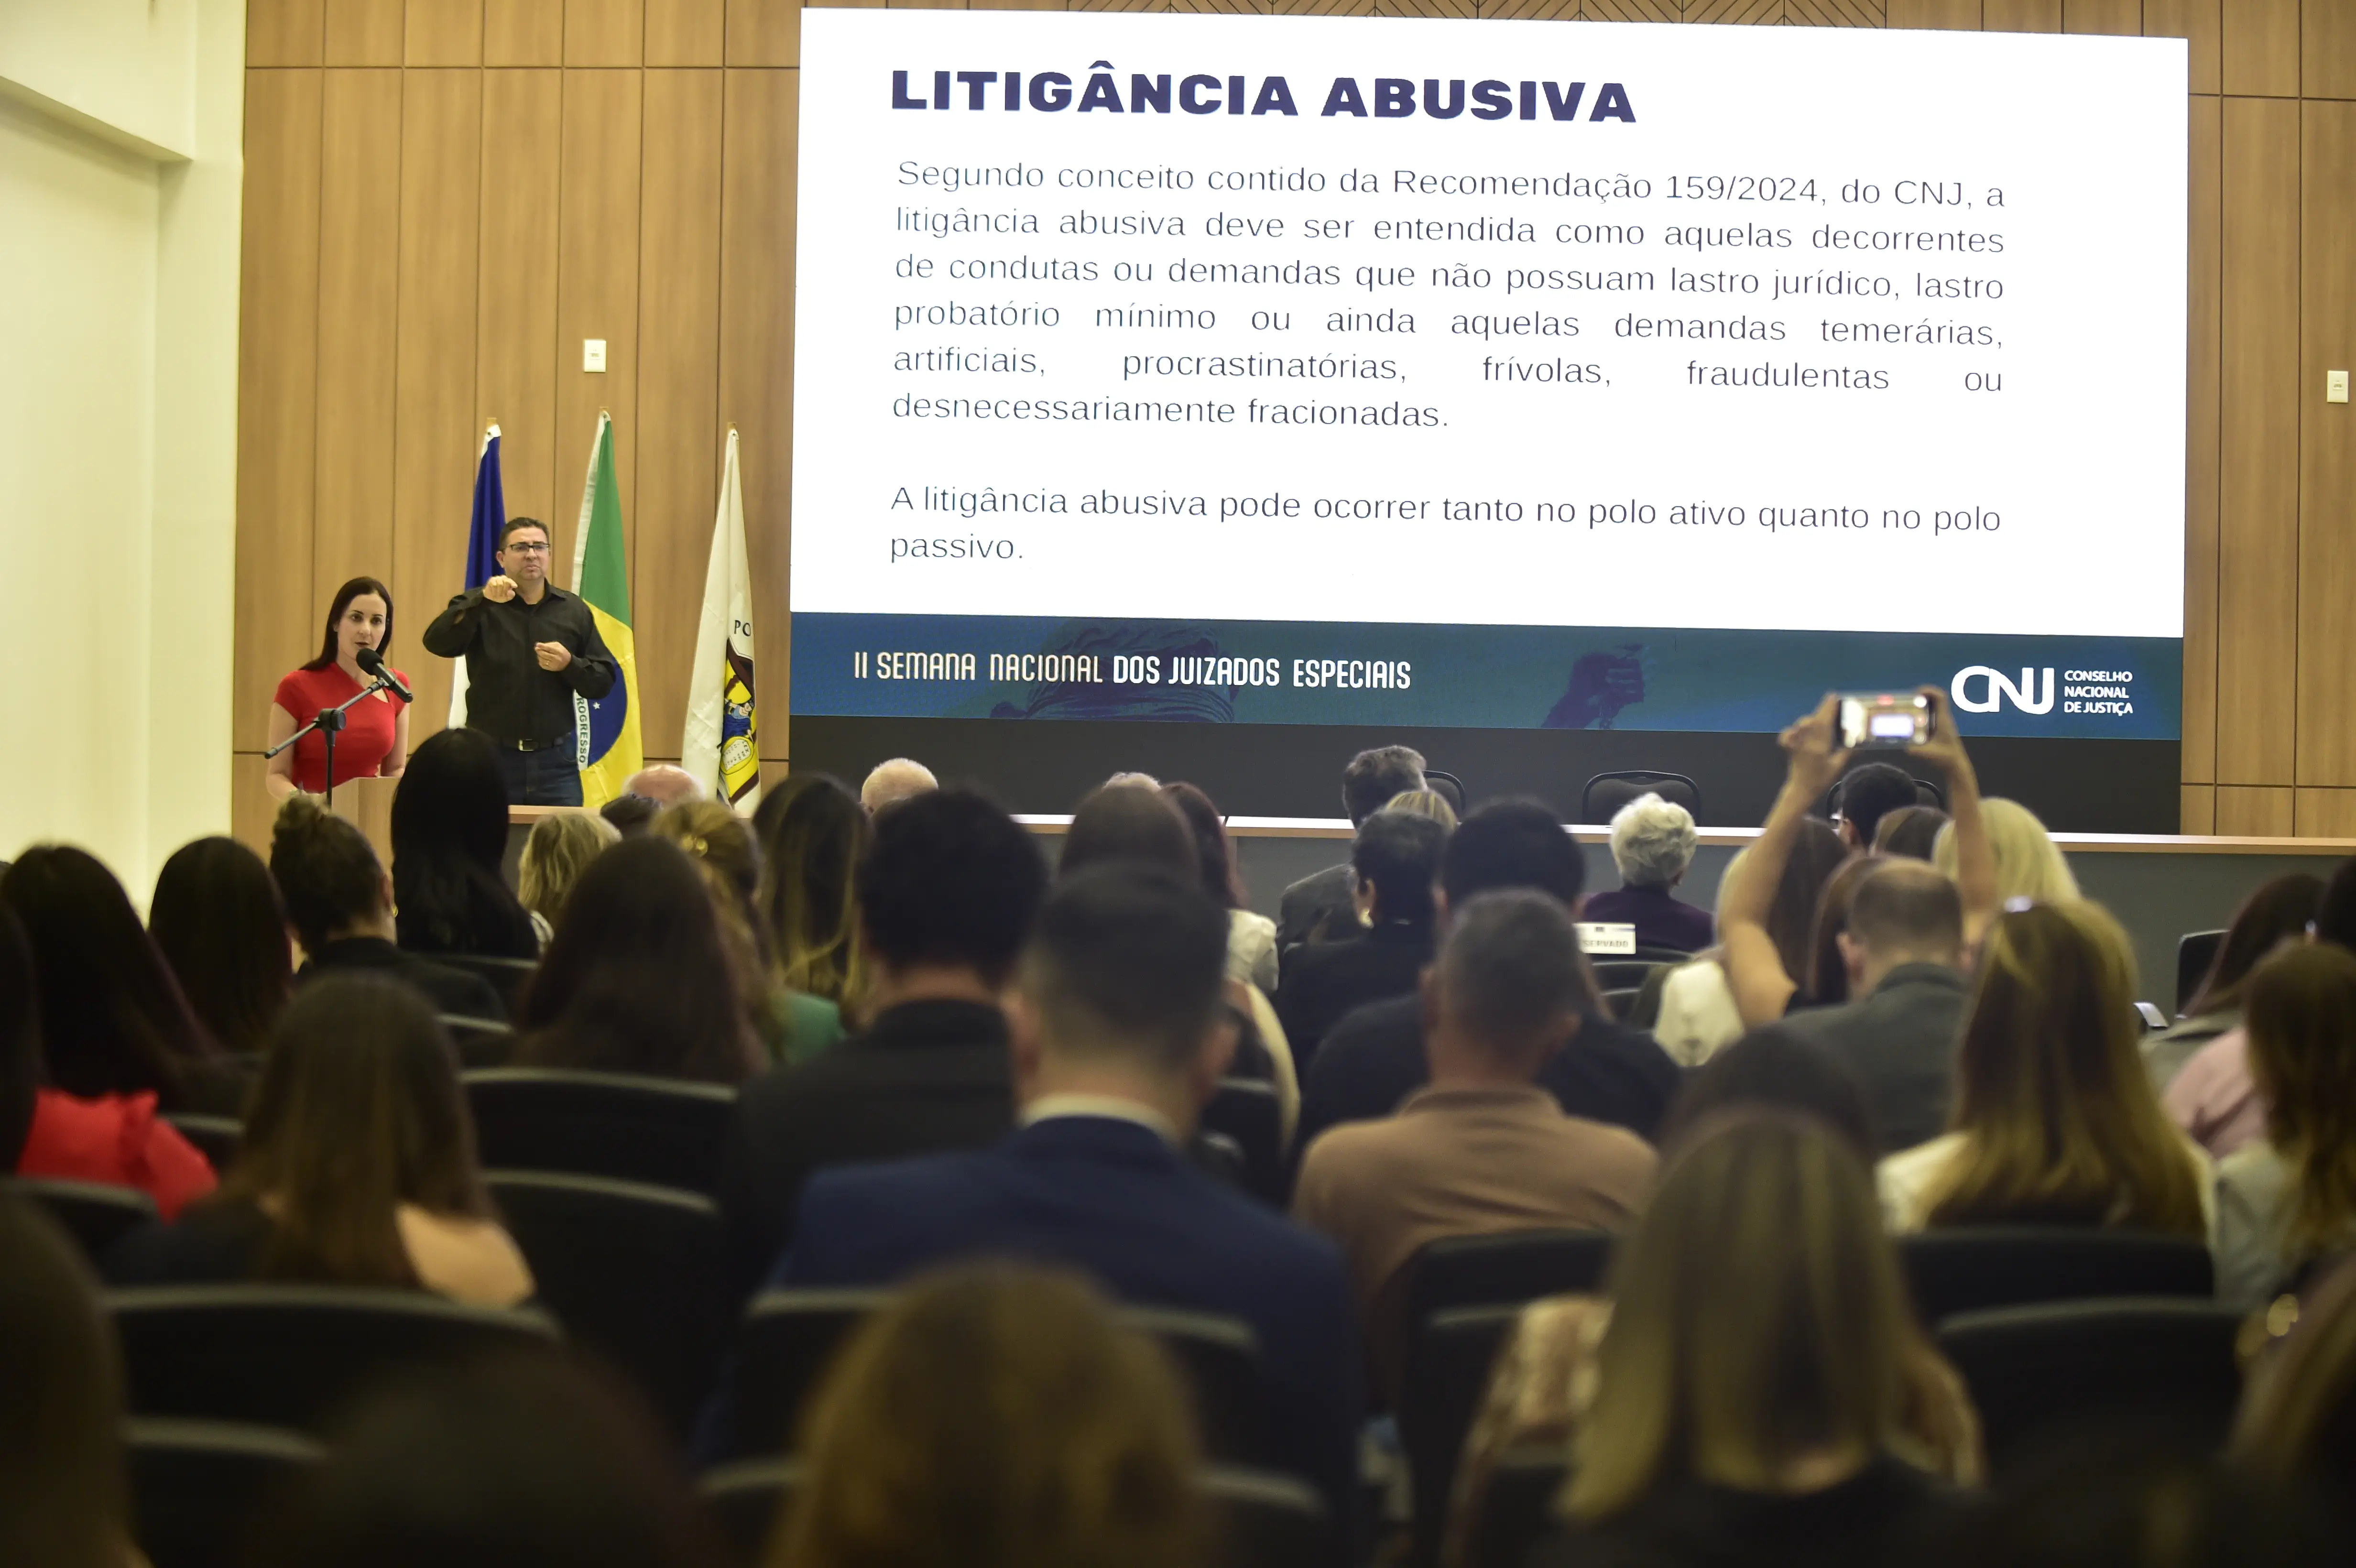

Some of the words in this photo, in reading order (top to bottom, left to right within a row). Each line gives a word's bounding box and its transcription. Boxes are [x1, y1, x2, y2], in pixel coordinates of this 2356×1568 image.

[892, 60, 1298, 116] LITIGÂNCIA
[1321, 77, 1636, 123] ABUSIVA
[899, 162, 1043, 192] Segundo
[1059, 165, 1193, 189] conceito
[1209, 167, 1325, 191] contido
[1341, 168, 1379, 193] da
[1395, 171, 1651, 204] Recomendação
[1667, 176, 1825, 206] 159/2024,
[1843, 179, 1879, 203] do
[1895, 181, 1971, 209] CNJ,
[1987, 188, 2004, 207] a
[898, 207, 1039, 238] litigância
[1060, 210, 1186, 235] abusiva
[1207, 212, 1284, 237] deve
[1304, 220, 1354, 238] ser
[1374, 217, 1536, 242] entendida
[1557, 225, 1644, 244] como
[1665, 223, 1791, 252] aquelas
[1813, 224, 2003, 252] decorrentes
[896, 254, 933, 278] de
[950, 255, 1098, 280] condutas
[1114, 262, 1151, 281] ou
[1169, 258, 1340, 284] demandas
[1356, 267, 1414, 292] que
[1433, 263, 1490, 287] não
[1508, 270, 1653, 294] possuam
[1672, 267, 1758, 293] lastro
[1772, 270, 1898, 300] jurídico,
[1918, 273, 2003, 298] lastro
[896, 301, 1059, 330] probatório
[1097, 303, 1215, 329] mínimo
[1252, 312, 1289, 330] ou
[1328, 308, 1416, 333] ainda
[1452, 311, 1579, 341] aquelas
[1615, 313, 1785, 340] demandas
[1821, 318, 2001, 348] temerárias,
[894, 347, 1044, 376] artificiais,
[1124, 352, 1405, 383] procrastinatórias,
[1483, 356, 1609, 387] frívolas,
[1687, 360, 1888, 389] fraudulentas
[1965, 373, 2000, 391] ou
[894, 393, 1234, 422] desnecessariamente
[1248, 399, 1447, 426] fracionadas.
[891, 488, 913, 510] A
[926, 486, 1068, 518] litigância
[1081, 489, 1207, 515] abusiva
[1222, 493, 1300, 523] pode
[1315, 499, 1430, 519] ocorrer
[1443, 499, 1522, 521] tanto
[1538, 503, 1575, 522] no
[1590, 499, 1655, 529] polo
[1670, 501, 1745, 525] ativo
[1759, 506, 1868, 533] quanto
[1884, 511, 1920, 529] no
[1935, 506, 1999, 536] polo
[892, 534, 1022, 563] passivo.
[855, 652, 867, 678] II
[877, 652, 975, 680] SEMANA
[990, 653, 1102, 683] NACIONAL
[1113, 655, 1160, 684] DOS
[1168, 656, 1280, 686] JUIZADOS
[1293, 659, 1411, 689] ESPECIAIS
[1951, 666, 2055, 715] CNJ
[2064, 670, 2133, 682] CONSELHO
[2064, 686, 2129, 698] NACIONAL
[576, 697, 588, 763] ROGRESSO
[2064, 701, 2081, 713] DE
[2083, 702, 2133, 716] JUSTIÇA
[1584, 940, 1628, 948] SERVADO
